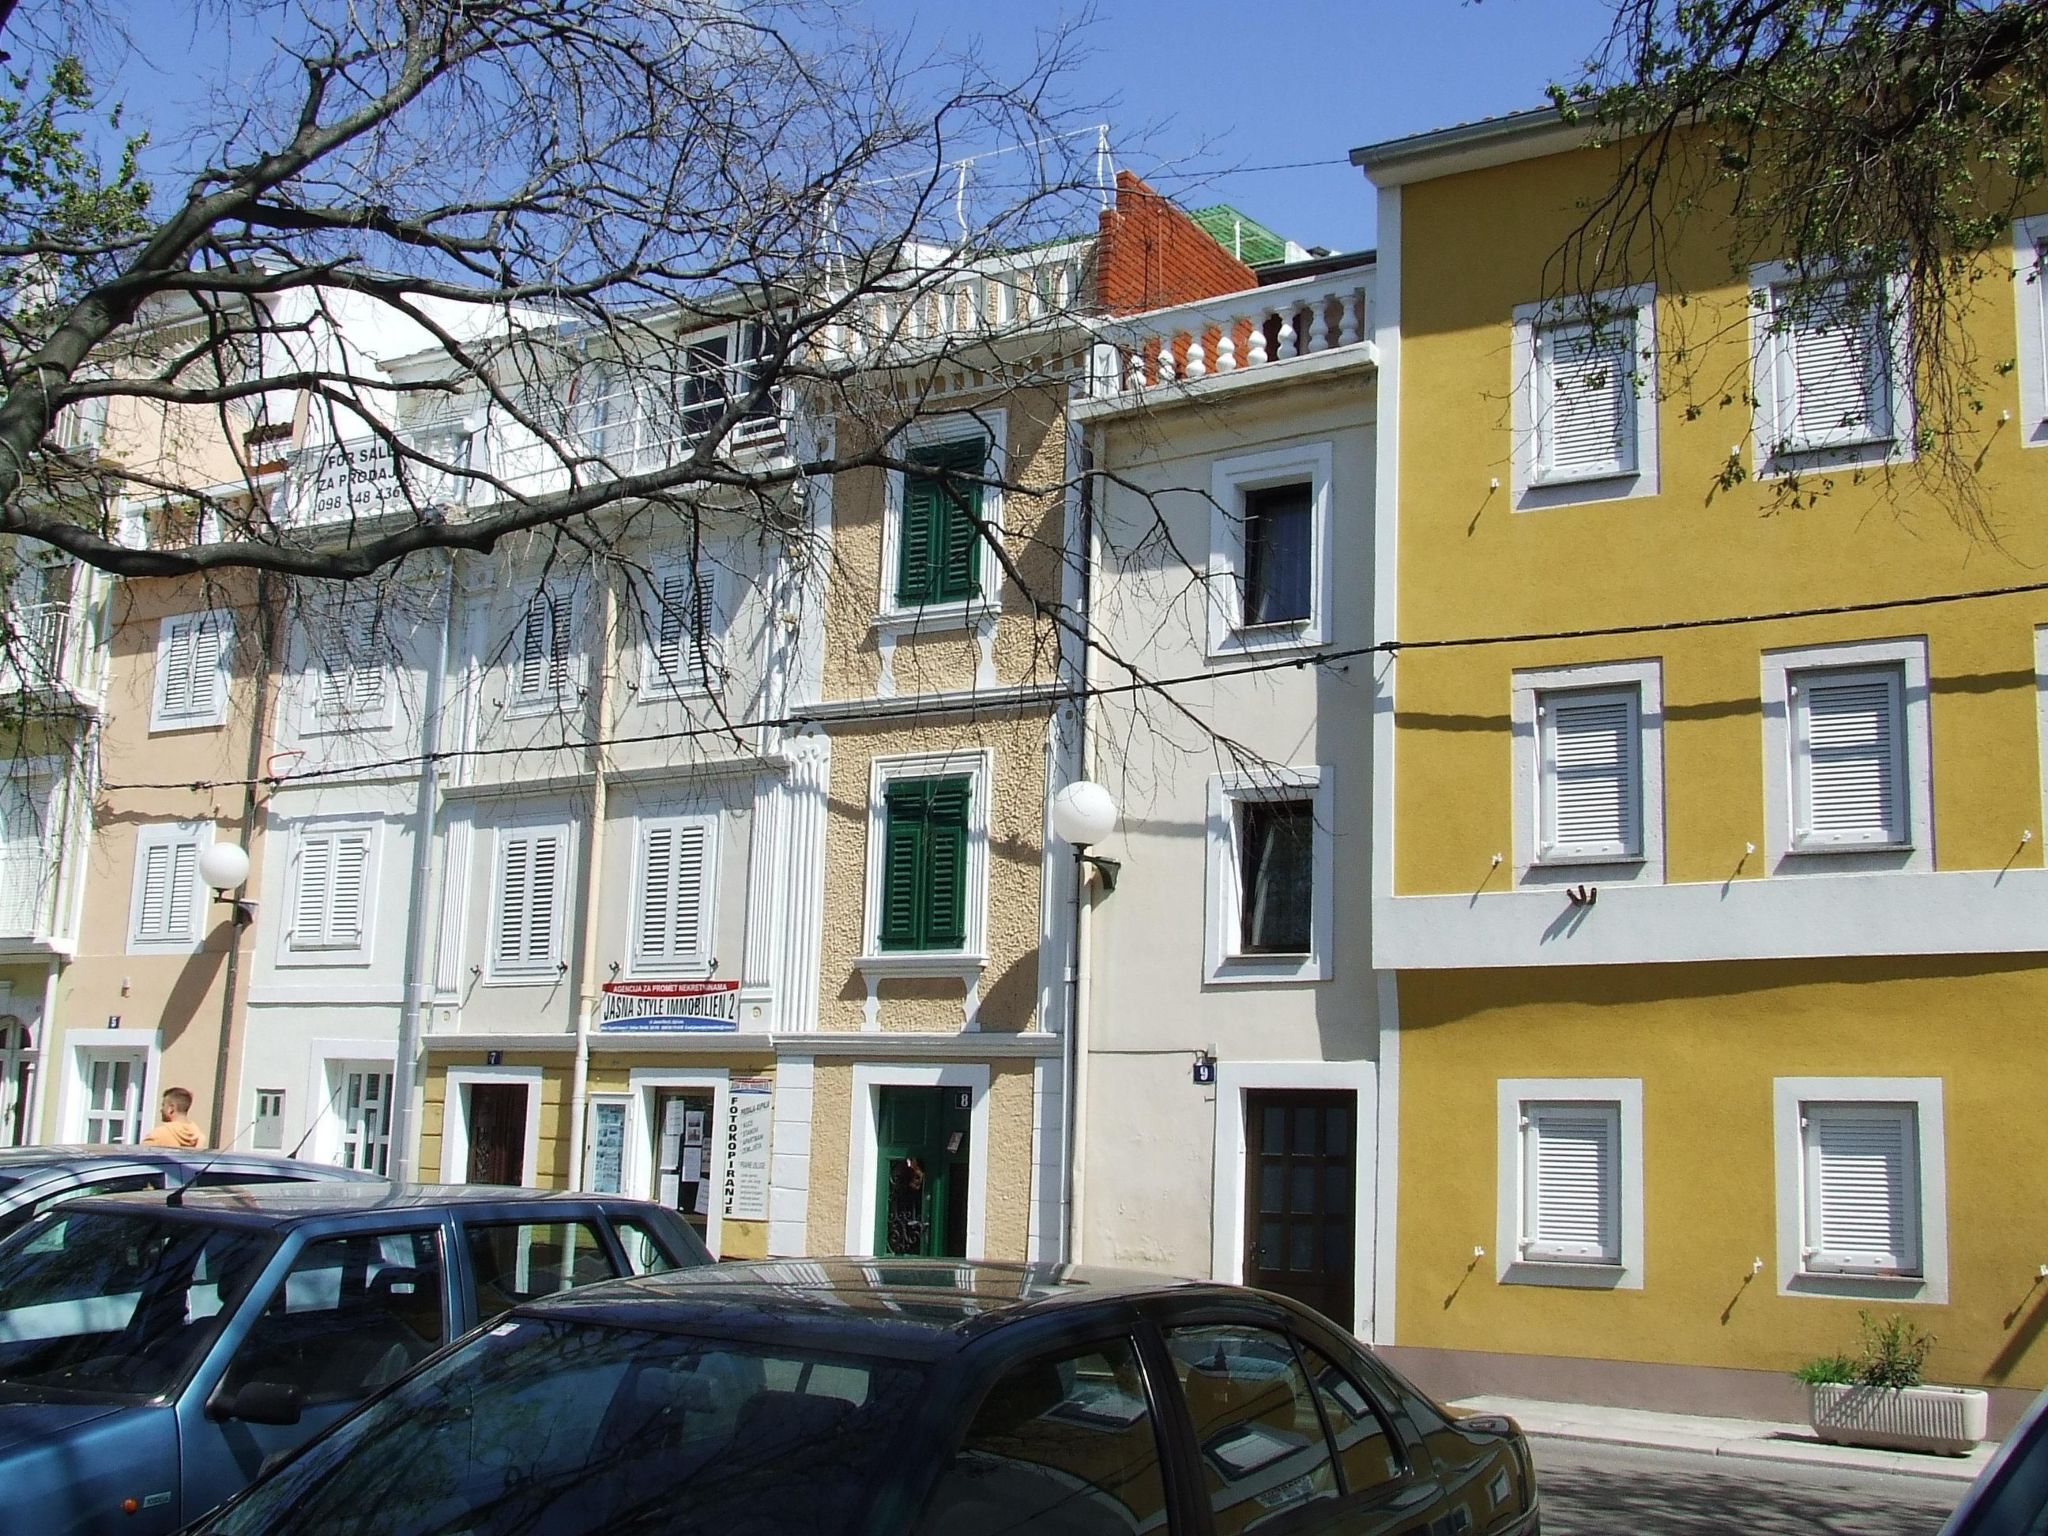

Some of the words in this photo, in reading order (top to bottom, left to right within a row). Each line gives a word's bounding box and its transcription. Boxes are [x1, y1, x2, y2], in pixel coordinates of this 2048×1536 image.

[328, 452, 355, 469] FOR
[319, 478, 334, 491] ZA
[318, 496, 341, 511] 098
[613, 984, 642, 993] AGENCIJA
[643, 984, 651, 992] ZA
[652, 983, 677, 992] PROMET
[603, 995, 634, 1020] JASNA
[637, 998, 663, 1016] STYLE
[666, 994, 726, 1019] IMMOBILIEN
[728, 993, 735, 1019] 2
[490, 1052, 497, 1064] 7
[1200, 1066, 1208, 1080] 9
[961, 1093, 969, 1107] 8
[725, 1097, 738, 1214] FOTOKOPIRANJE
